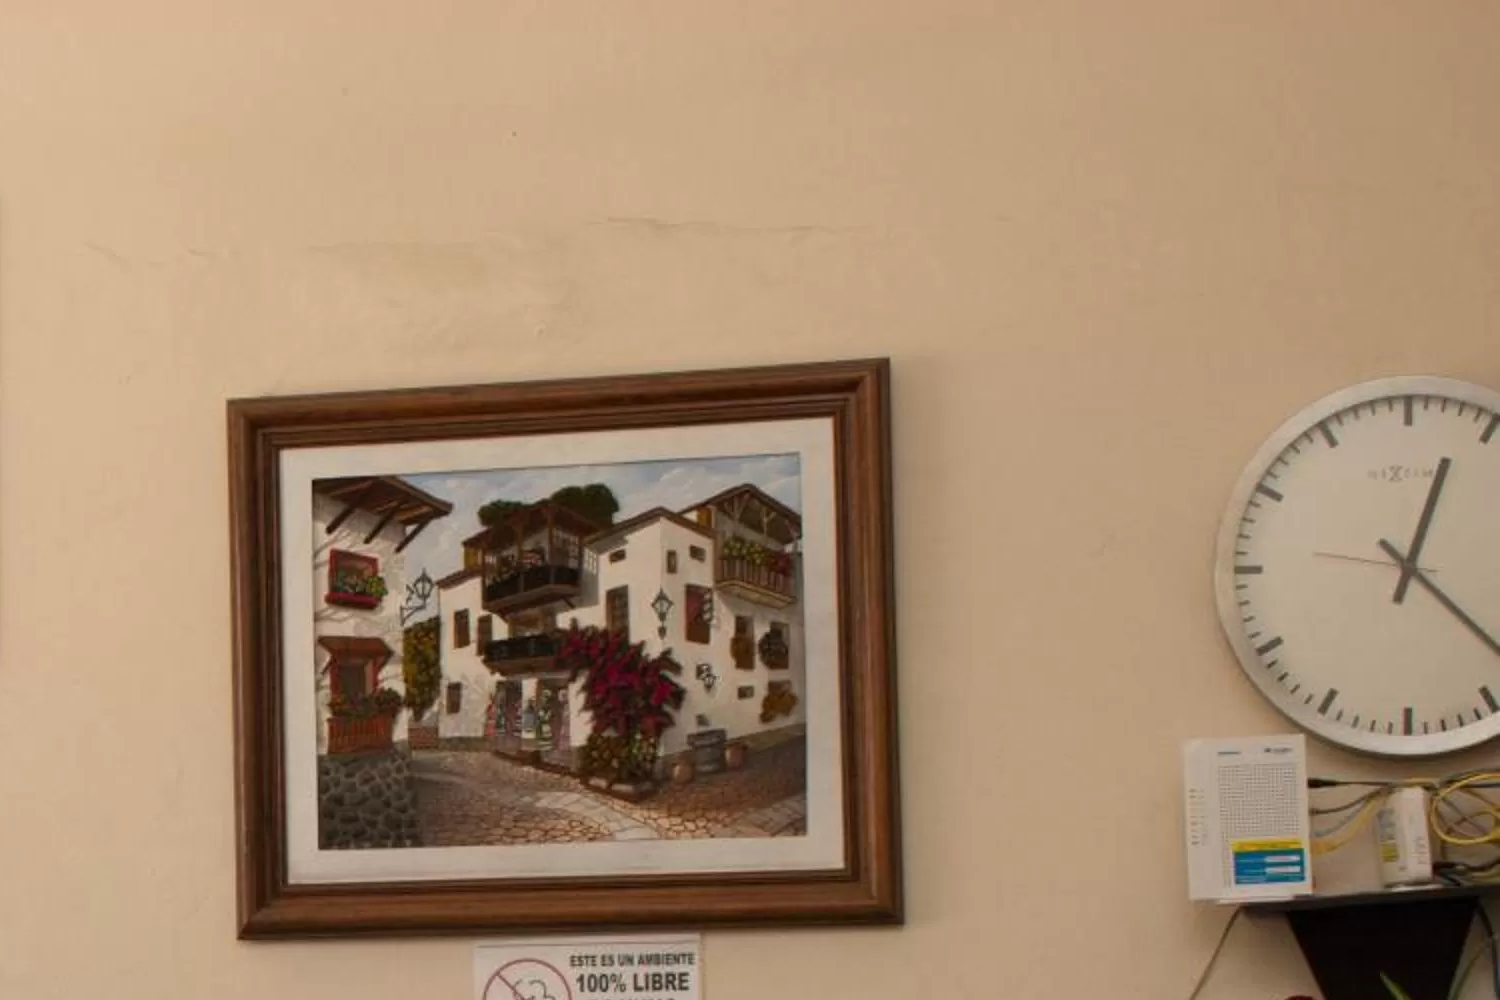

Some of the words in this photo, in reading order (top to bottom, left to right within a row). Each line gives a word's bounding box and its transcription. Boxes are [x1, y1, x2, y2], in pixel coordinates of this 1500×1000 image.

[570, 955, 596, 966] ESTE
[601, 954, 614, 966] ES
[618, 954, 633, 965] UN
[638, 952, 695, 966] AMBIENTE
[576, 974, 626, 993] 100%
[633, 972, 690, 991] LIBRE
